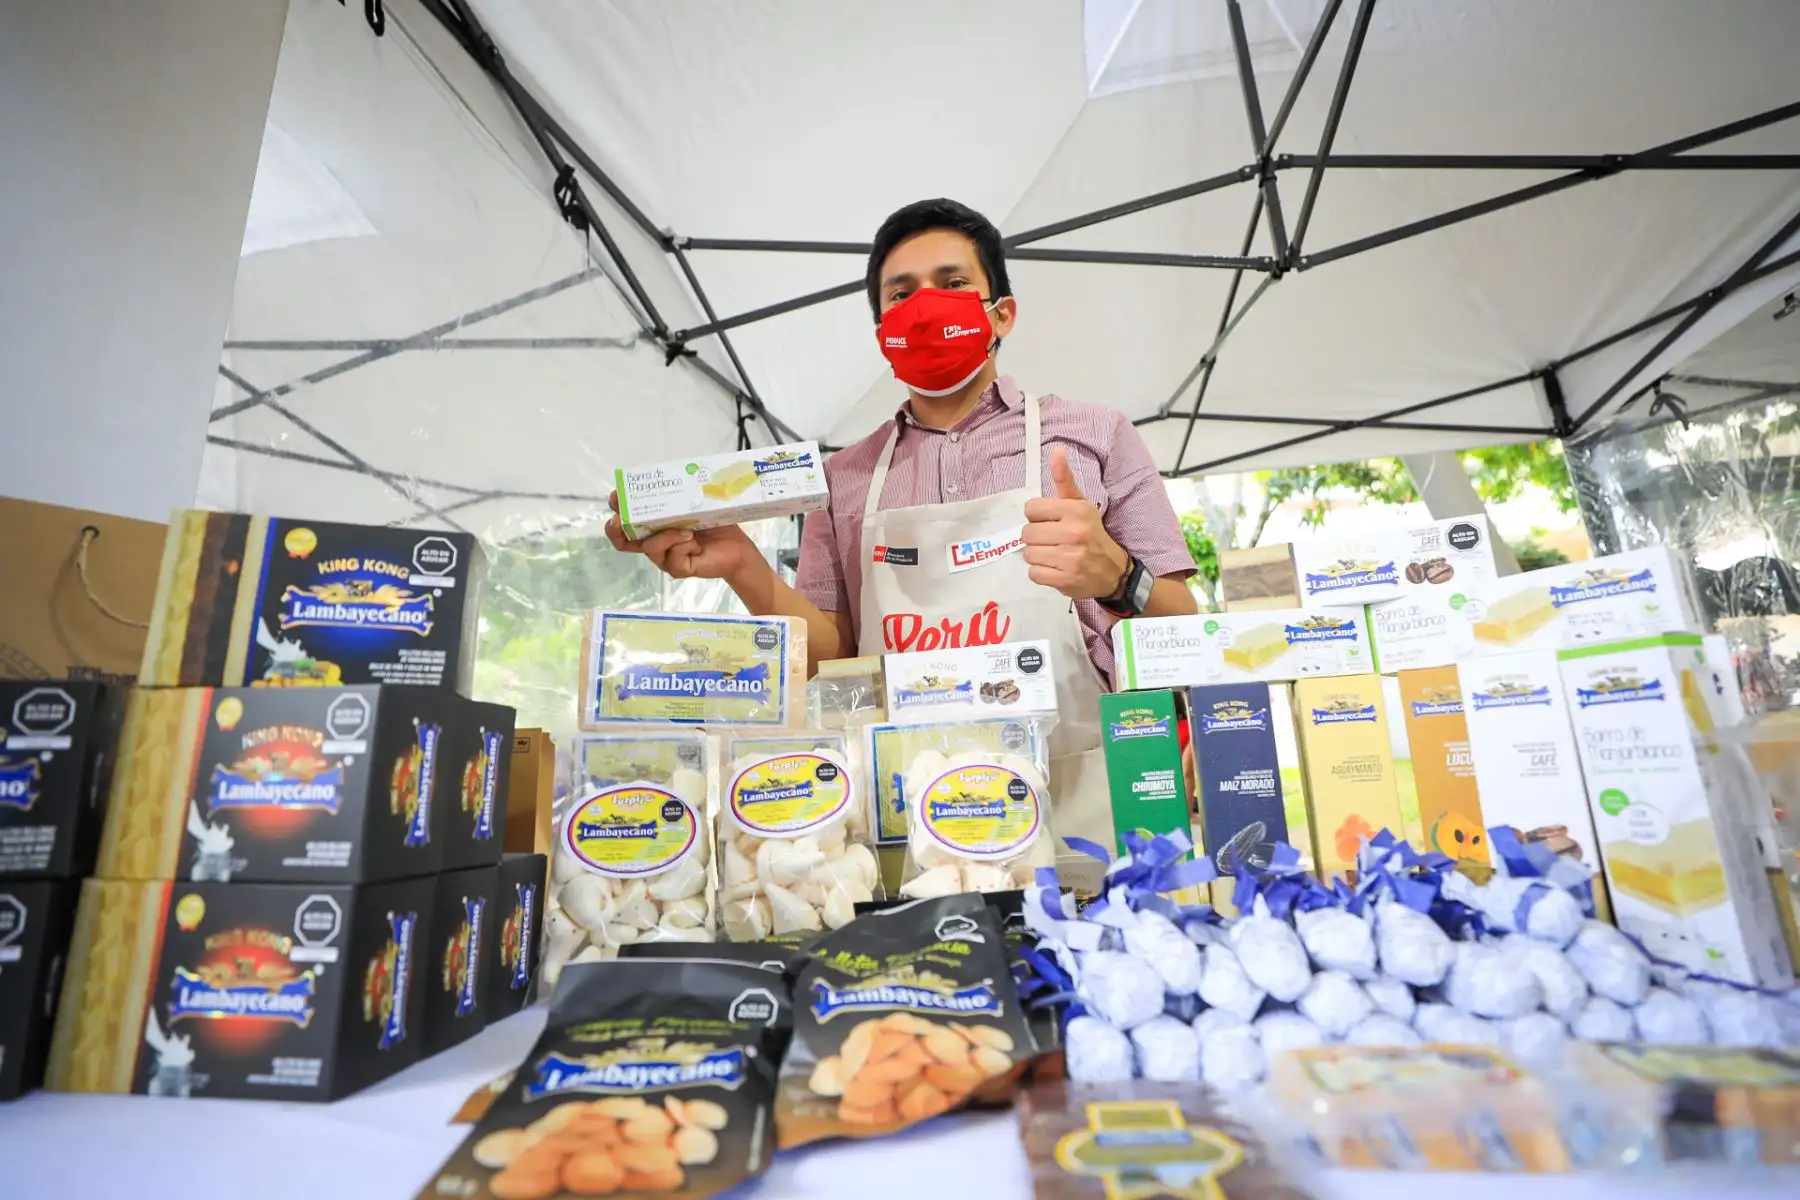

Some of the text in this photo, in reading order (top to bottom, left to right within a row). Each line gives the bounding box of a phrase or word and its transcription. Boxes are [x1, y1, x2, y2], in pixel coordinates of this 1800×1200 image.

[954, 327, 981, 337] Empresa
[758, 459, 811, 473] Lambayecano
[972, 540, 992, 550] Tu
[975, 537, 1024, 562] Empres
[317, 558, 411, 579] KING KONG
[1312, 570, 1394, 590] Lambayecano
[1557, 579, 1650, 601] Lambayecano
[292, 601, 423, 625] Lambayecano
[1290, 628, 1353, 641] Lambayecano
[627, 672, 762, 697] Lambayecano
[899, 688, 969, 704] Lambayecano
[1316, 712, 1374, 723] Lambayecano
[1415, 704, 1465, 714] Lambayeca
[1114, 726, 1166, 736] Lambayecano
[1207, 719, 1262, 729] Lambayecano
[219, 781, 336, 805] Lambayecano
[414, 730, 435, 837] Lambayecano
[480, 738, 497, 831] Lambayecano
[1132, 780, 1176, 792] CHIRIMOYA
[1240, 779, 1275, 790] MORADO
[743, 788, 809, 803] Lambayecano
[935, 804, 1002, 818] Lambayecano
[583, 827, 654, 839] Lambayecano
[518, 890, 532, 980] Lambayecano
[463, 903, 480, 1007] Lambayecano
[389, 919, 410, 1038] Lambayecano
[180, 986, 305, 1014] Lambayecano
[828, 985, 990, 1010] Lambayecano
[546, 1059, 733, 1091] Lambayecano
